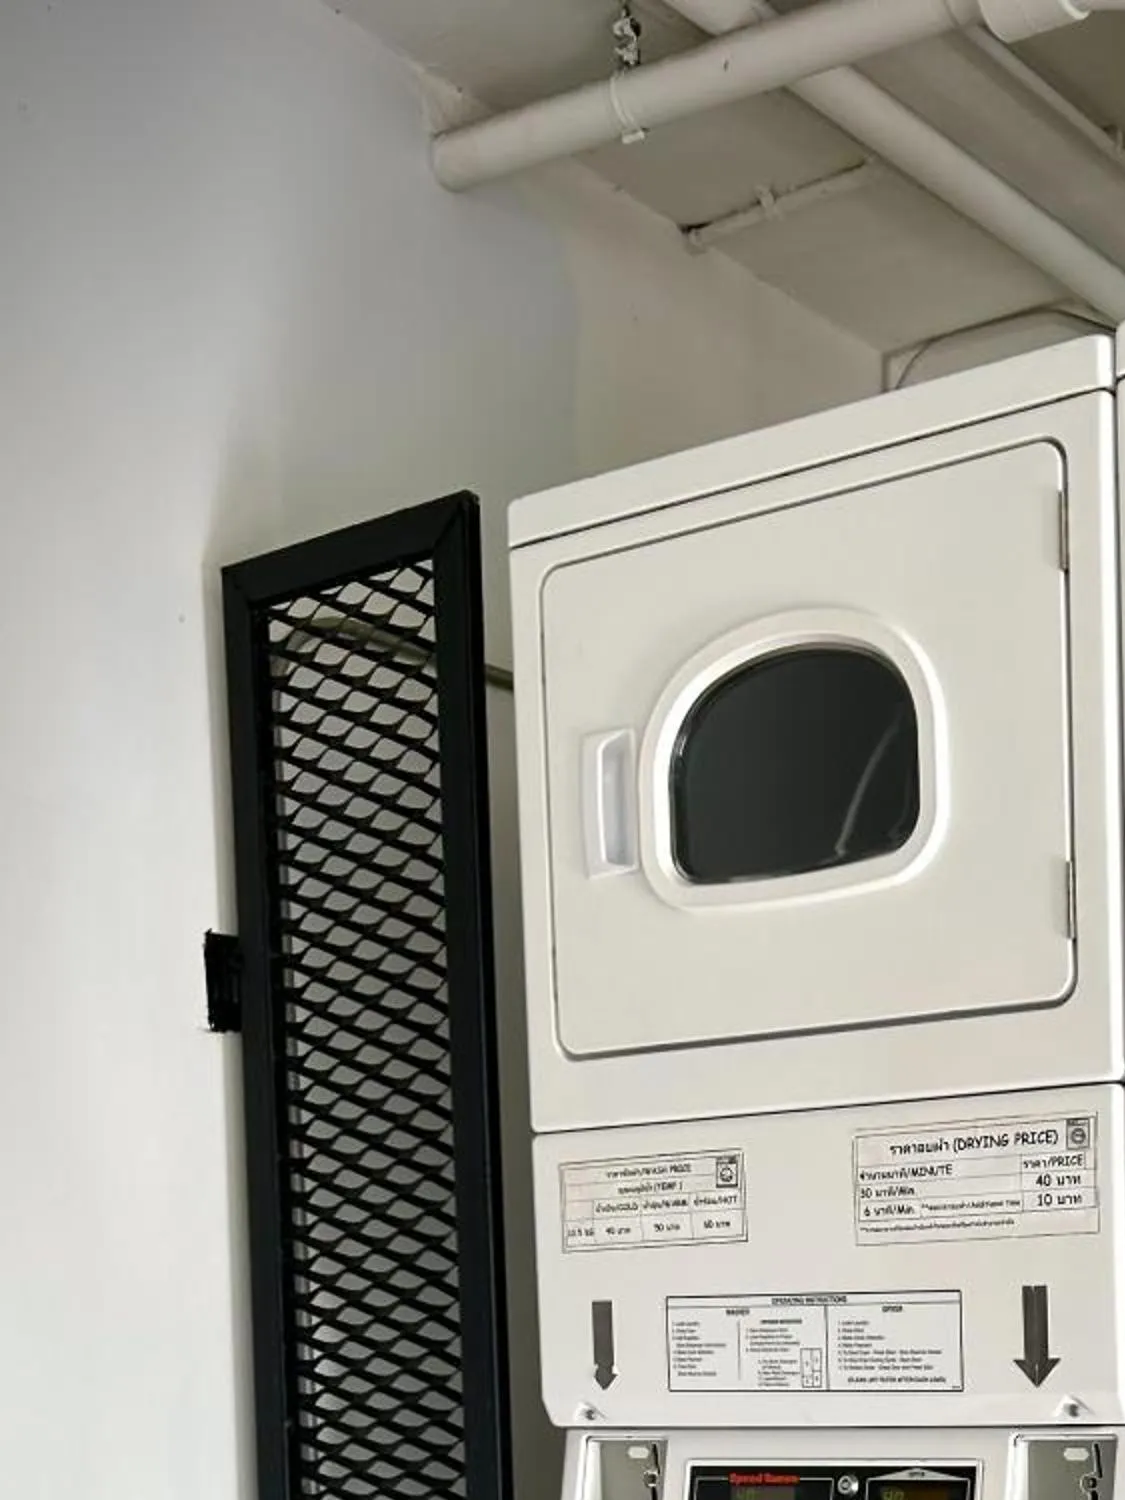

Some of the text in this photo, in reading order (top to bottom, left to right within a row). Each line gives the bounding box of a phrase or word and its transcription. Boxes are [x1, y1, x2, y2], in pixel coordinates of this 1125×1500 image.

[953, 1133, 1008, 1153] (DRYING
[1013, 1130, 1058, 1145] PRICE)
[1035, 1173, 1081, 1186] 40 บาท
[1038, 1193, 1082, 1207] 10 บาท
[729, 1473, 799, 1486] Speed Queen
